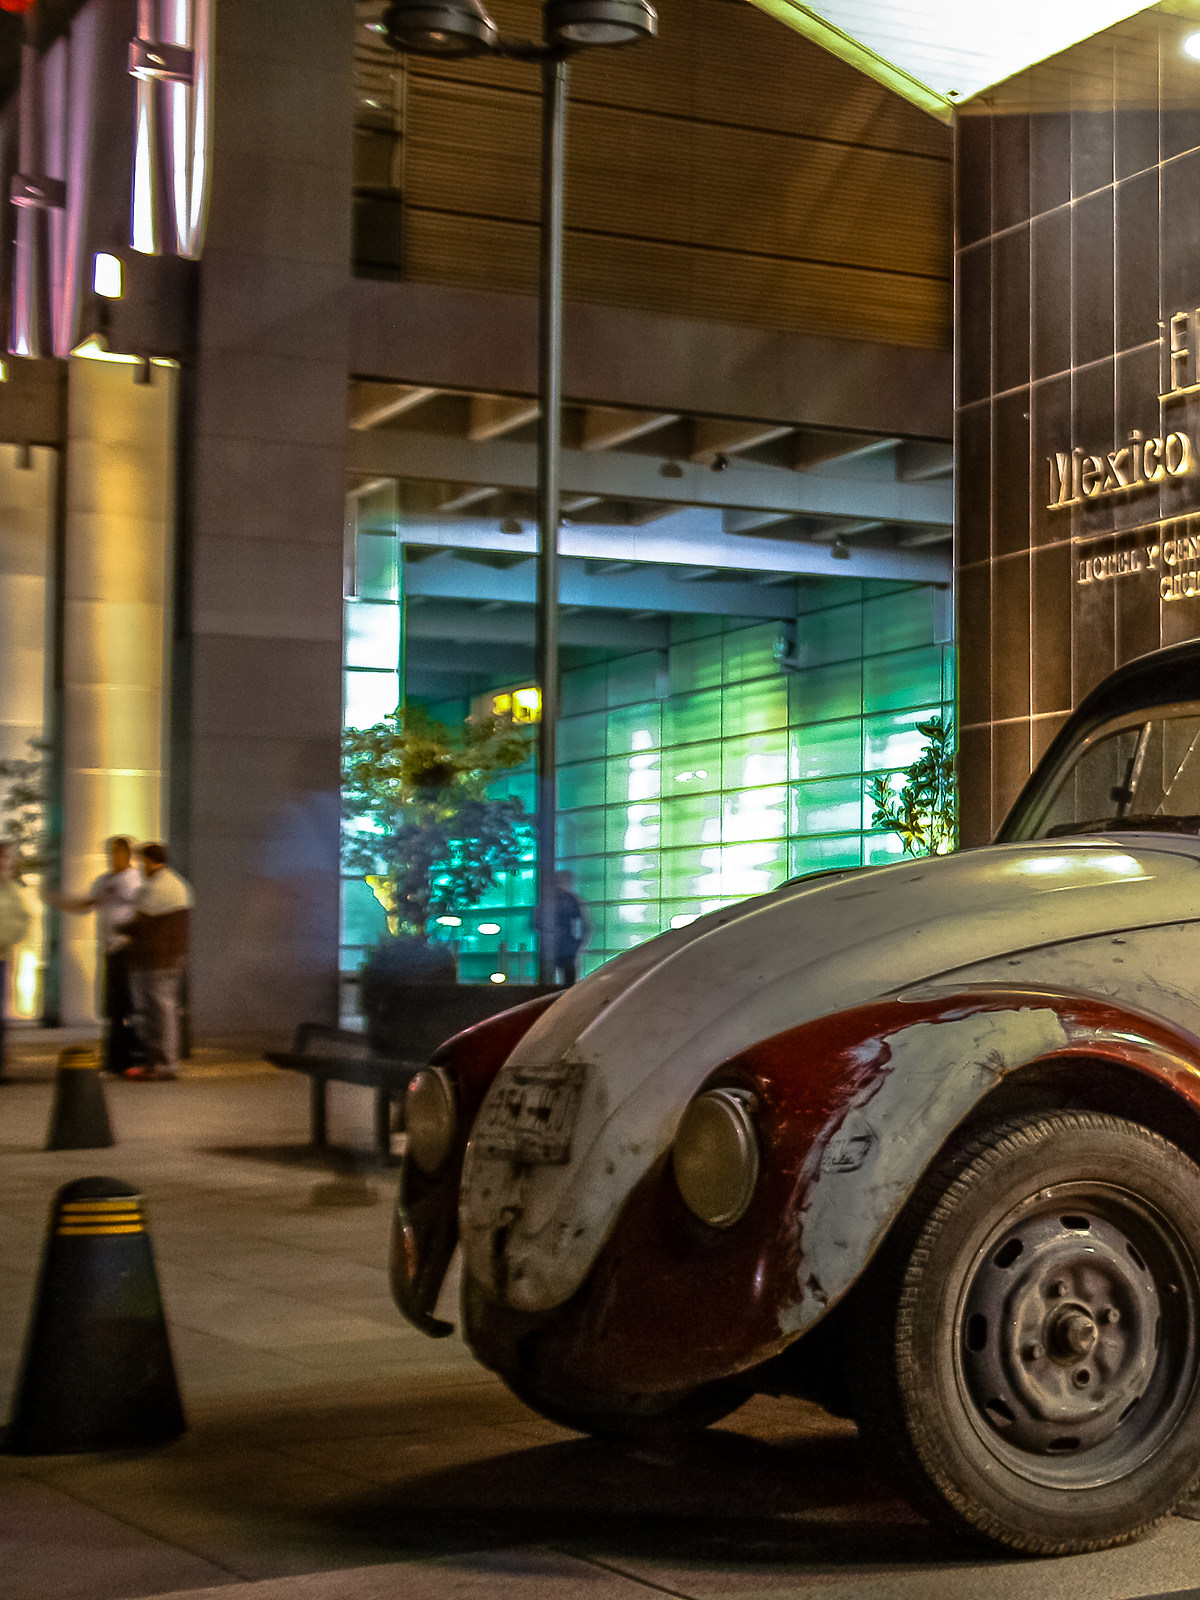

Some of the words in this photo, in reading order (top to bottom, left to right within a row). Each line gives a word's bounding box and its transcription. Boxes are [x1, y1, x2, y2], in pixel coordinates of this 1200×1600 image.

[1046, 428, 1192, 511] Mexico
[1077, 549, 1142, 585] HOTEL
[1143, 544, 1160, 569] Y
